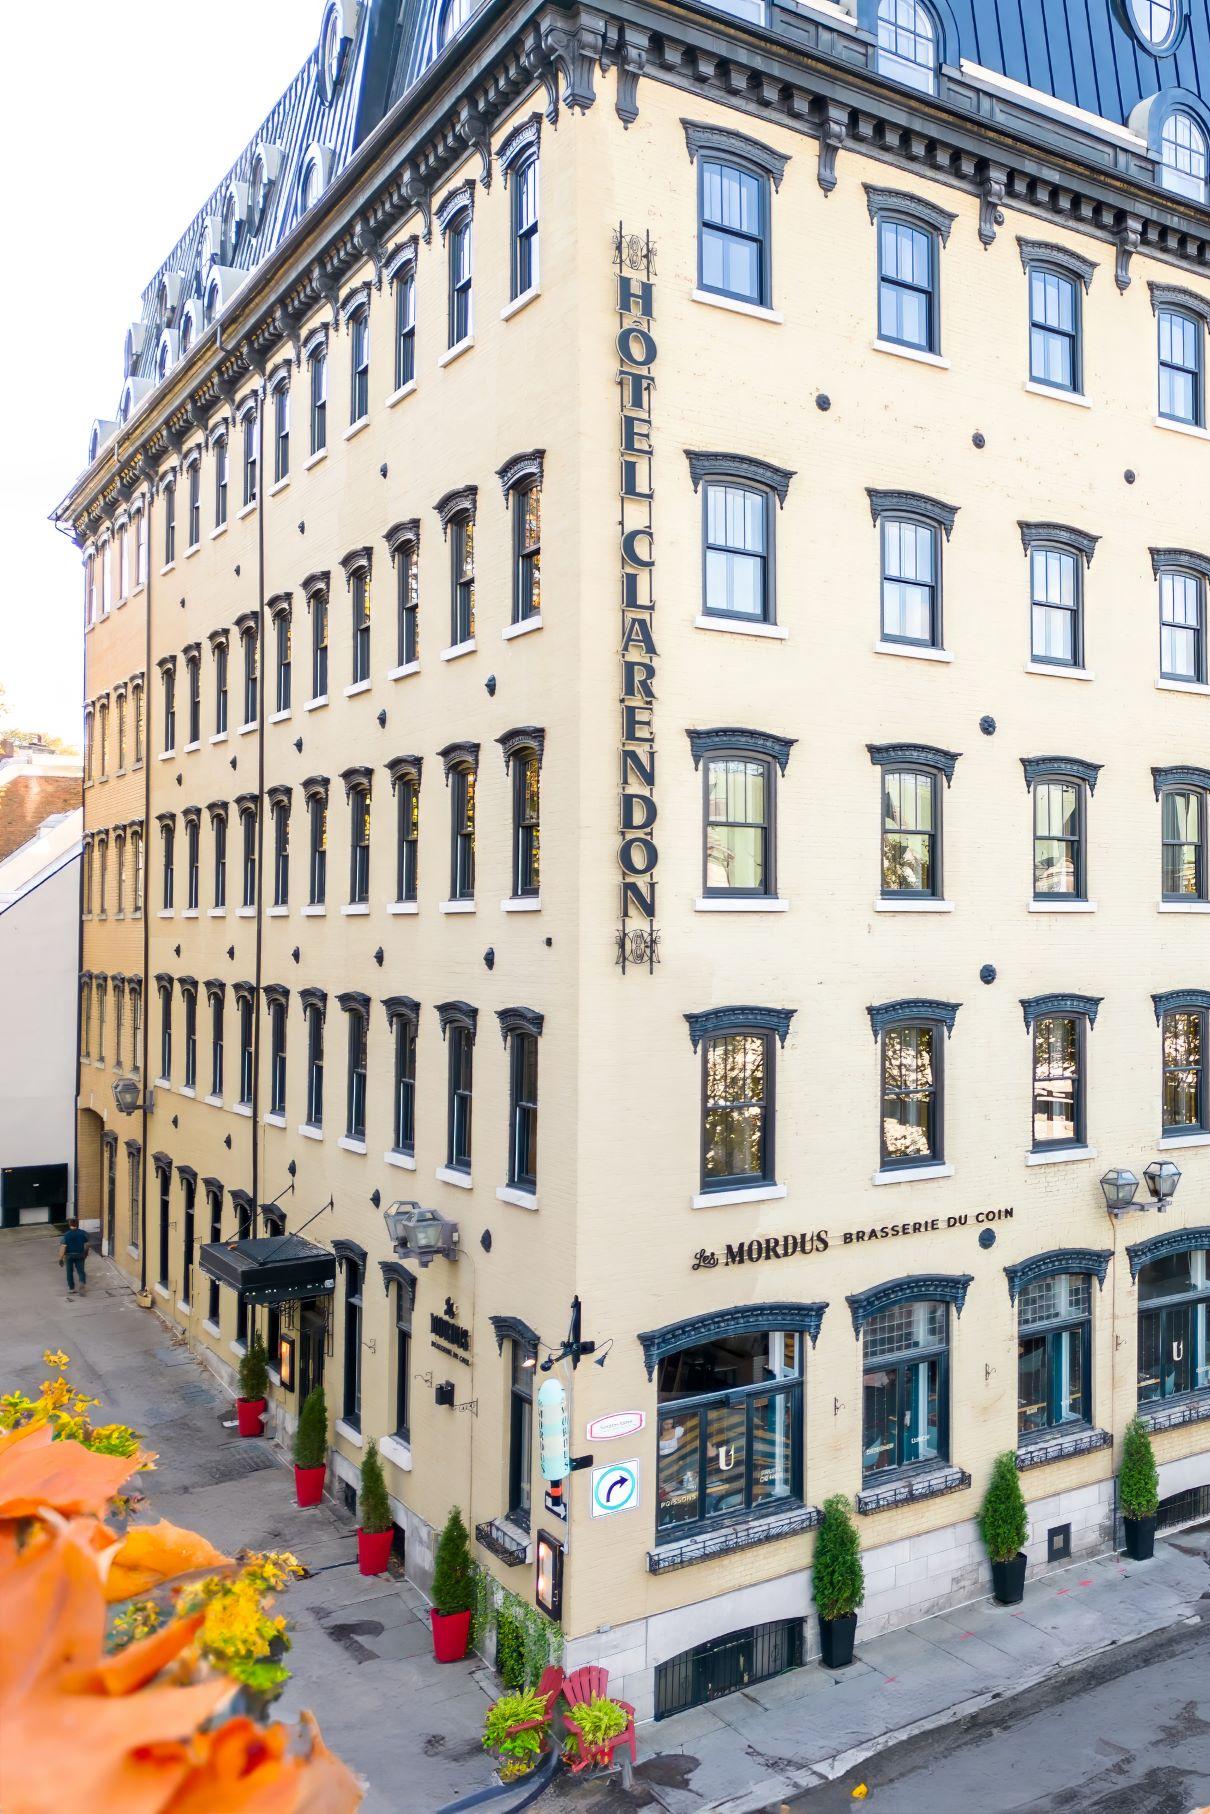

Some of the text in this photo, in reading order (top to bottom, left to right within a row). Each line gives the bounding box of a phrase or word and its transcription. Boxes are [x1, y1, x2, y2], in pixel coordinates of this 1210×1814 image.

[615, 271, 660, 920] HÔTEL CLARENDON
[692, 1207, 1014, 1270] Les MORDUS BRASSERIE DU COIN
